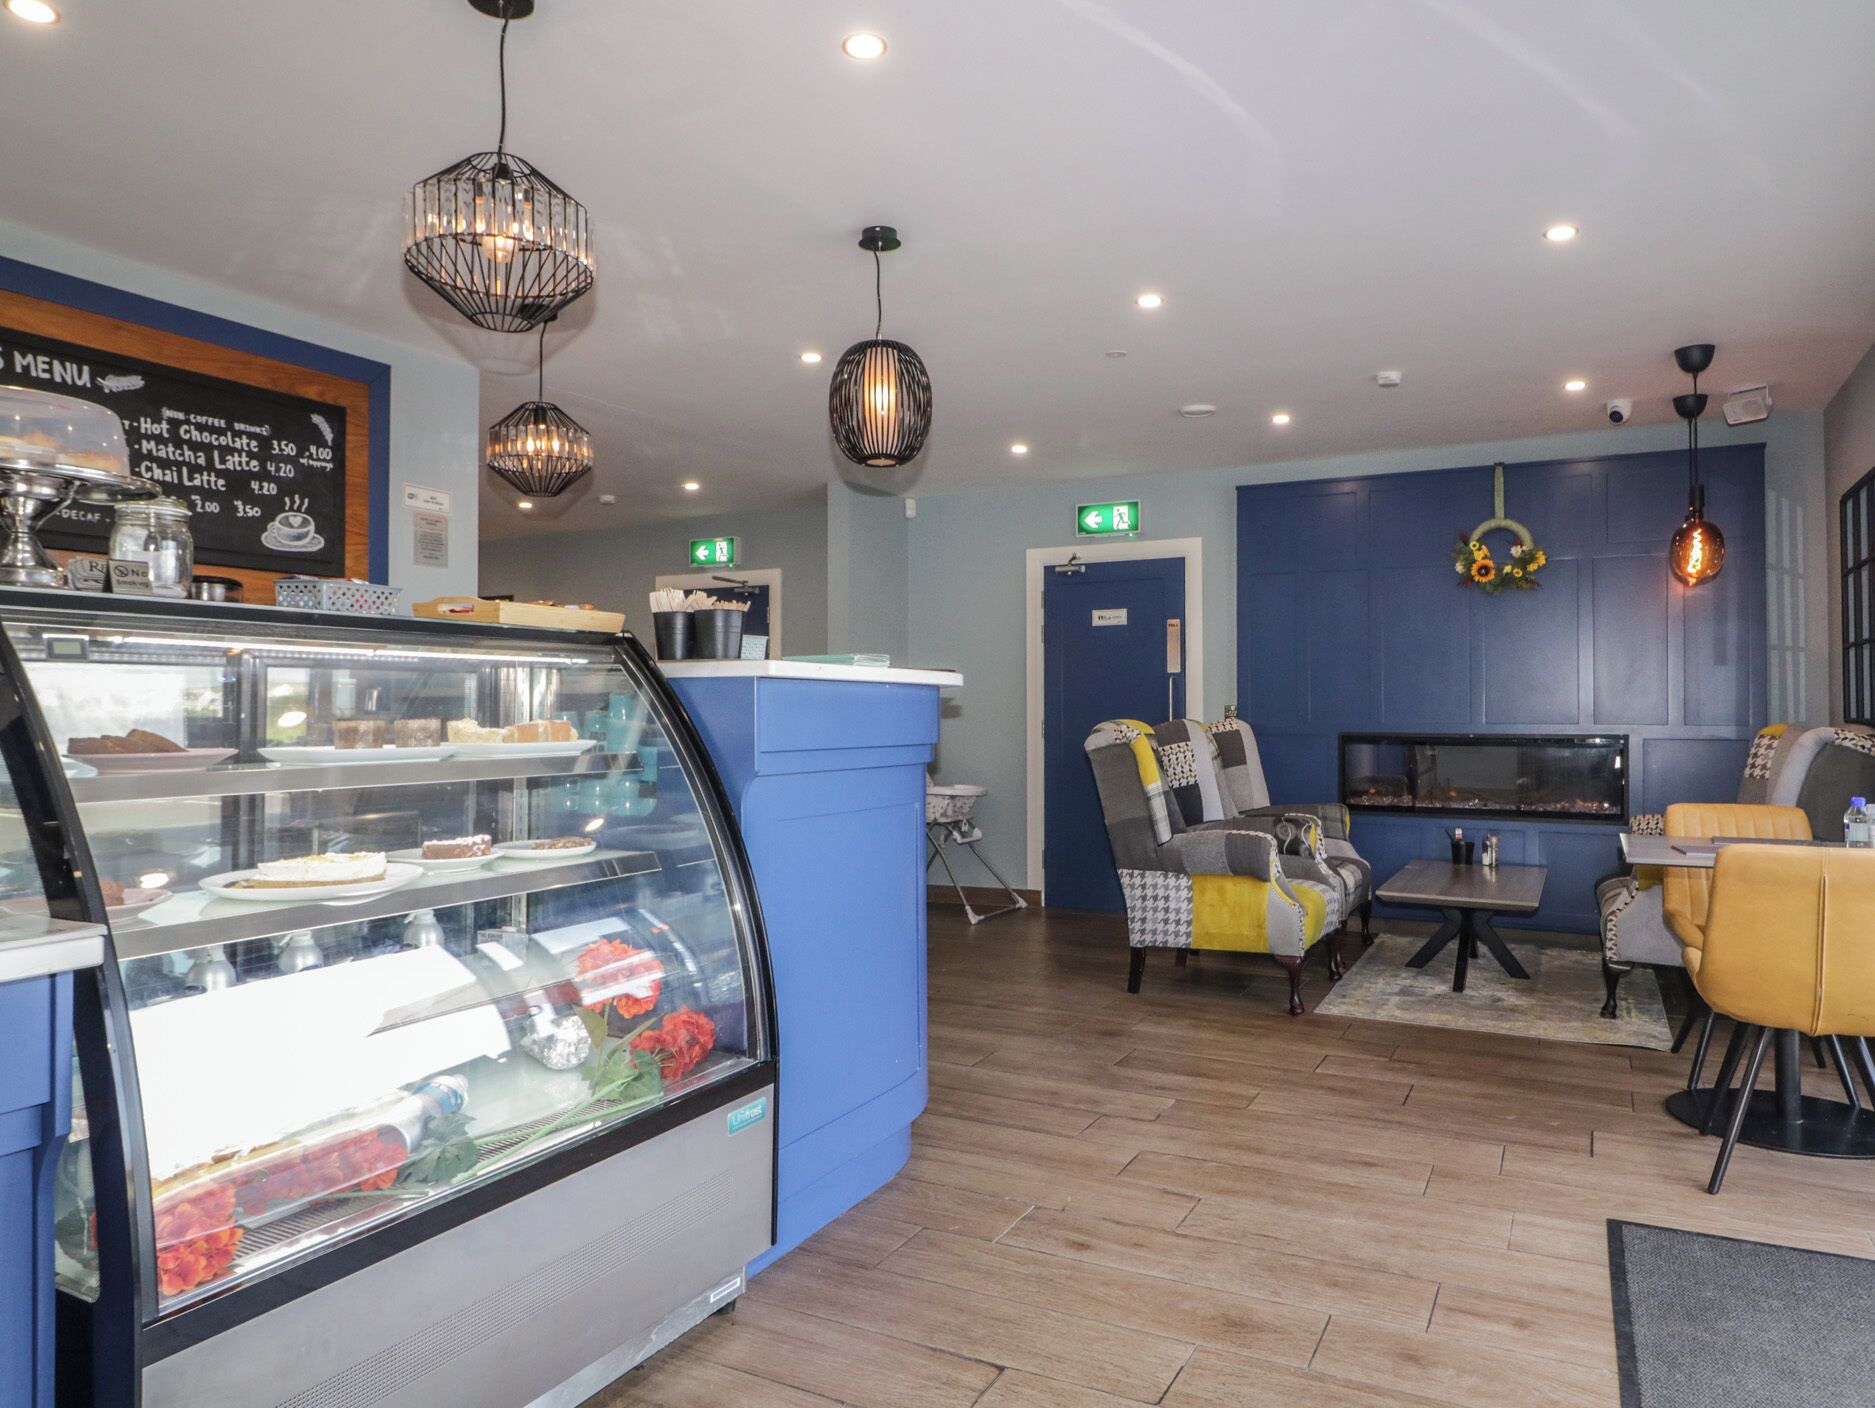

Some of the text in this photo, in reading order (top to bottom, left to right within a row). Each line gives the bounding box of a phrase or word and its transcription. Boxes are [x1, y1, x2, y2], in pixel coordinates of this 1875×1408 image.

[13, 350, 92, 388] MENU
[179, 424, 259, 452] Chocolate
[271, 440, 297, 456] 3.50
[213, 449, 260, 472] Latte
[266, 460, 295, 478] 4.20
[181, 465, 227, 491] Latte
[250, 480, 278, 495] 4.20
